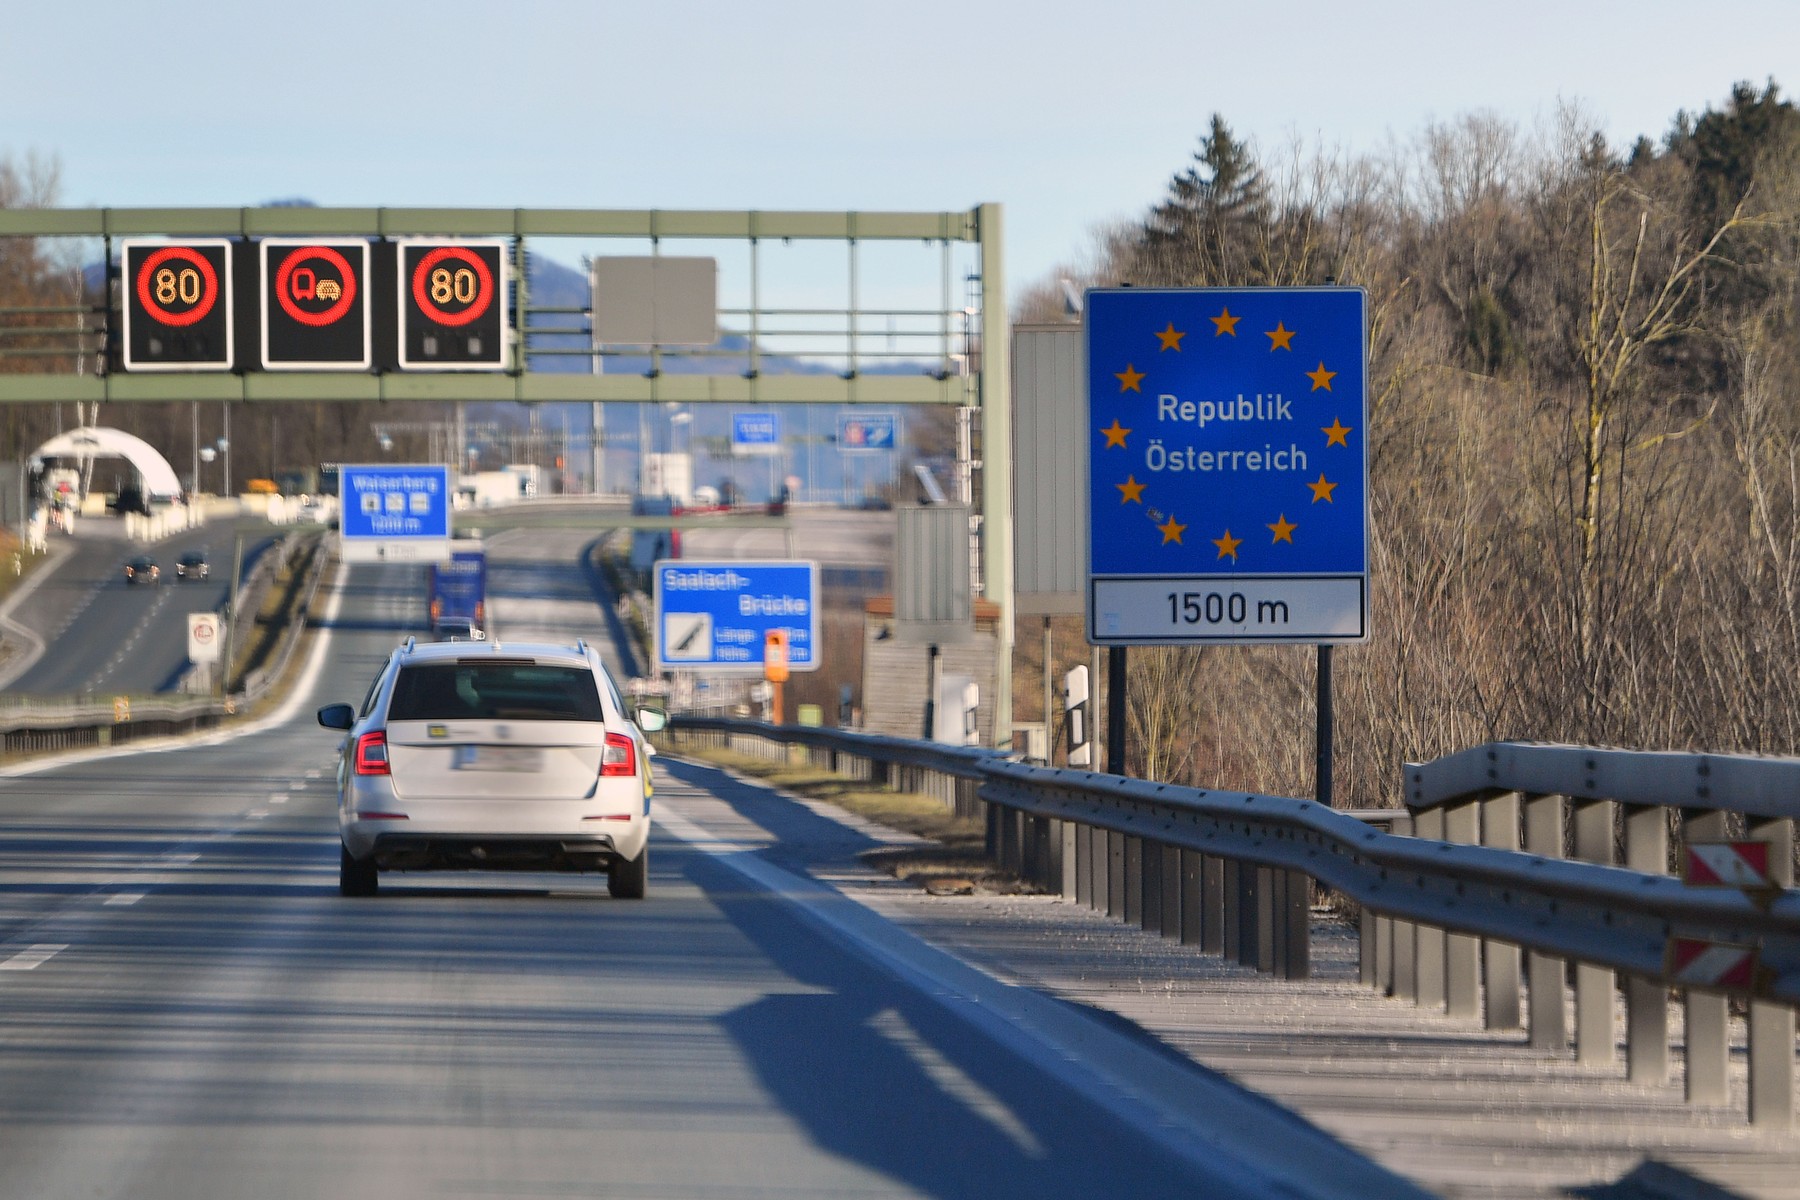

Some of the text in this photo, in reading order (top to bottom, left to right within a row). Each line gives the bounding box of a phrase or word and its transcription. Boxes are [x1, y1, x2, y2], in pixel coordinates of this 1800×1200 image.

[155, 268, 201, 305] 80
[430, 267, 478, 305] 80
[1157, 394, 1293, 428] Republik
[1145, 439, 1308, 471] Österreich
[664, 569, 750, 591] Saalach-
[738, 594, 808, 616] Brücke
[1167, 592, 1289, 624] 1500 m
